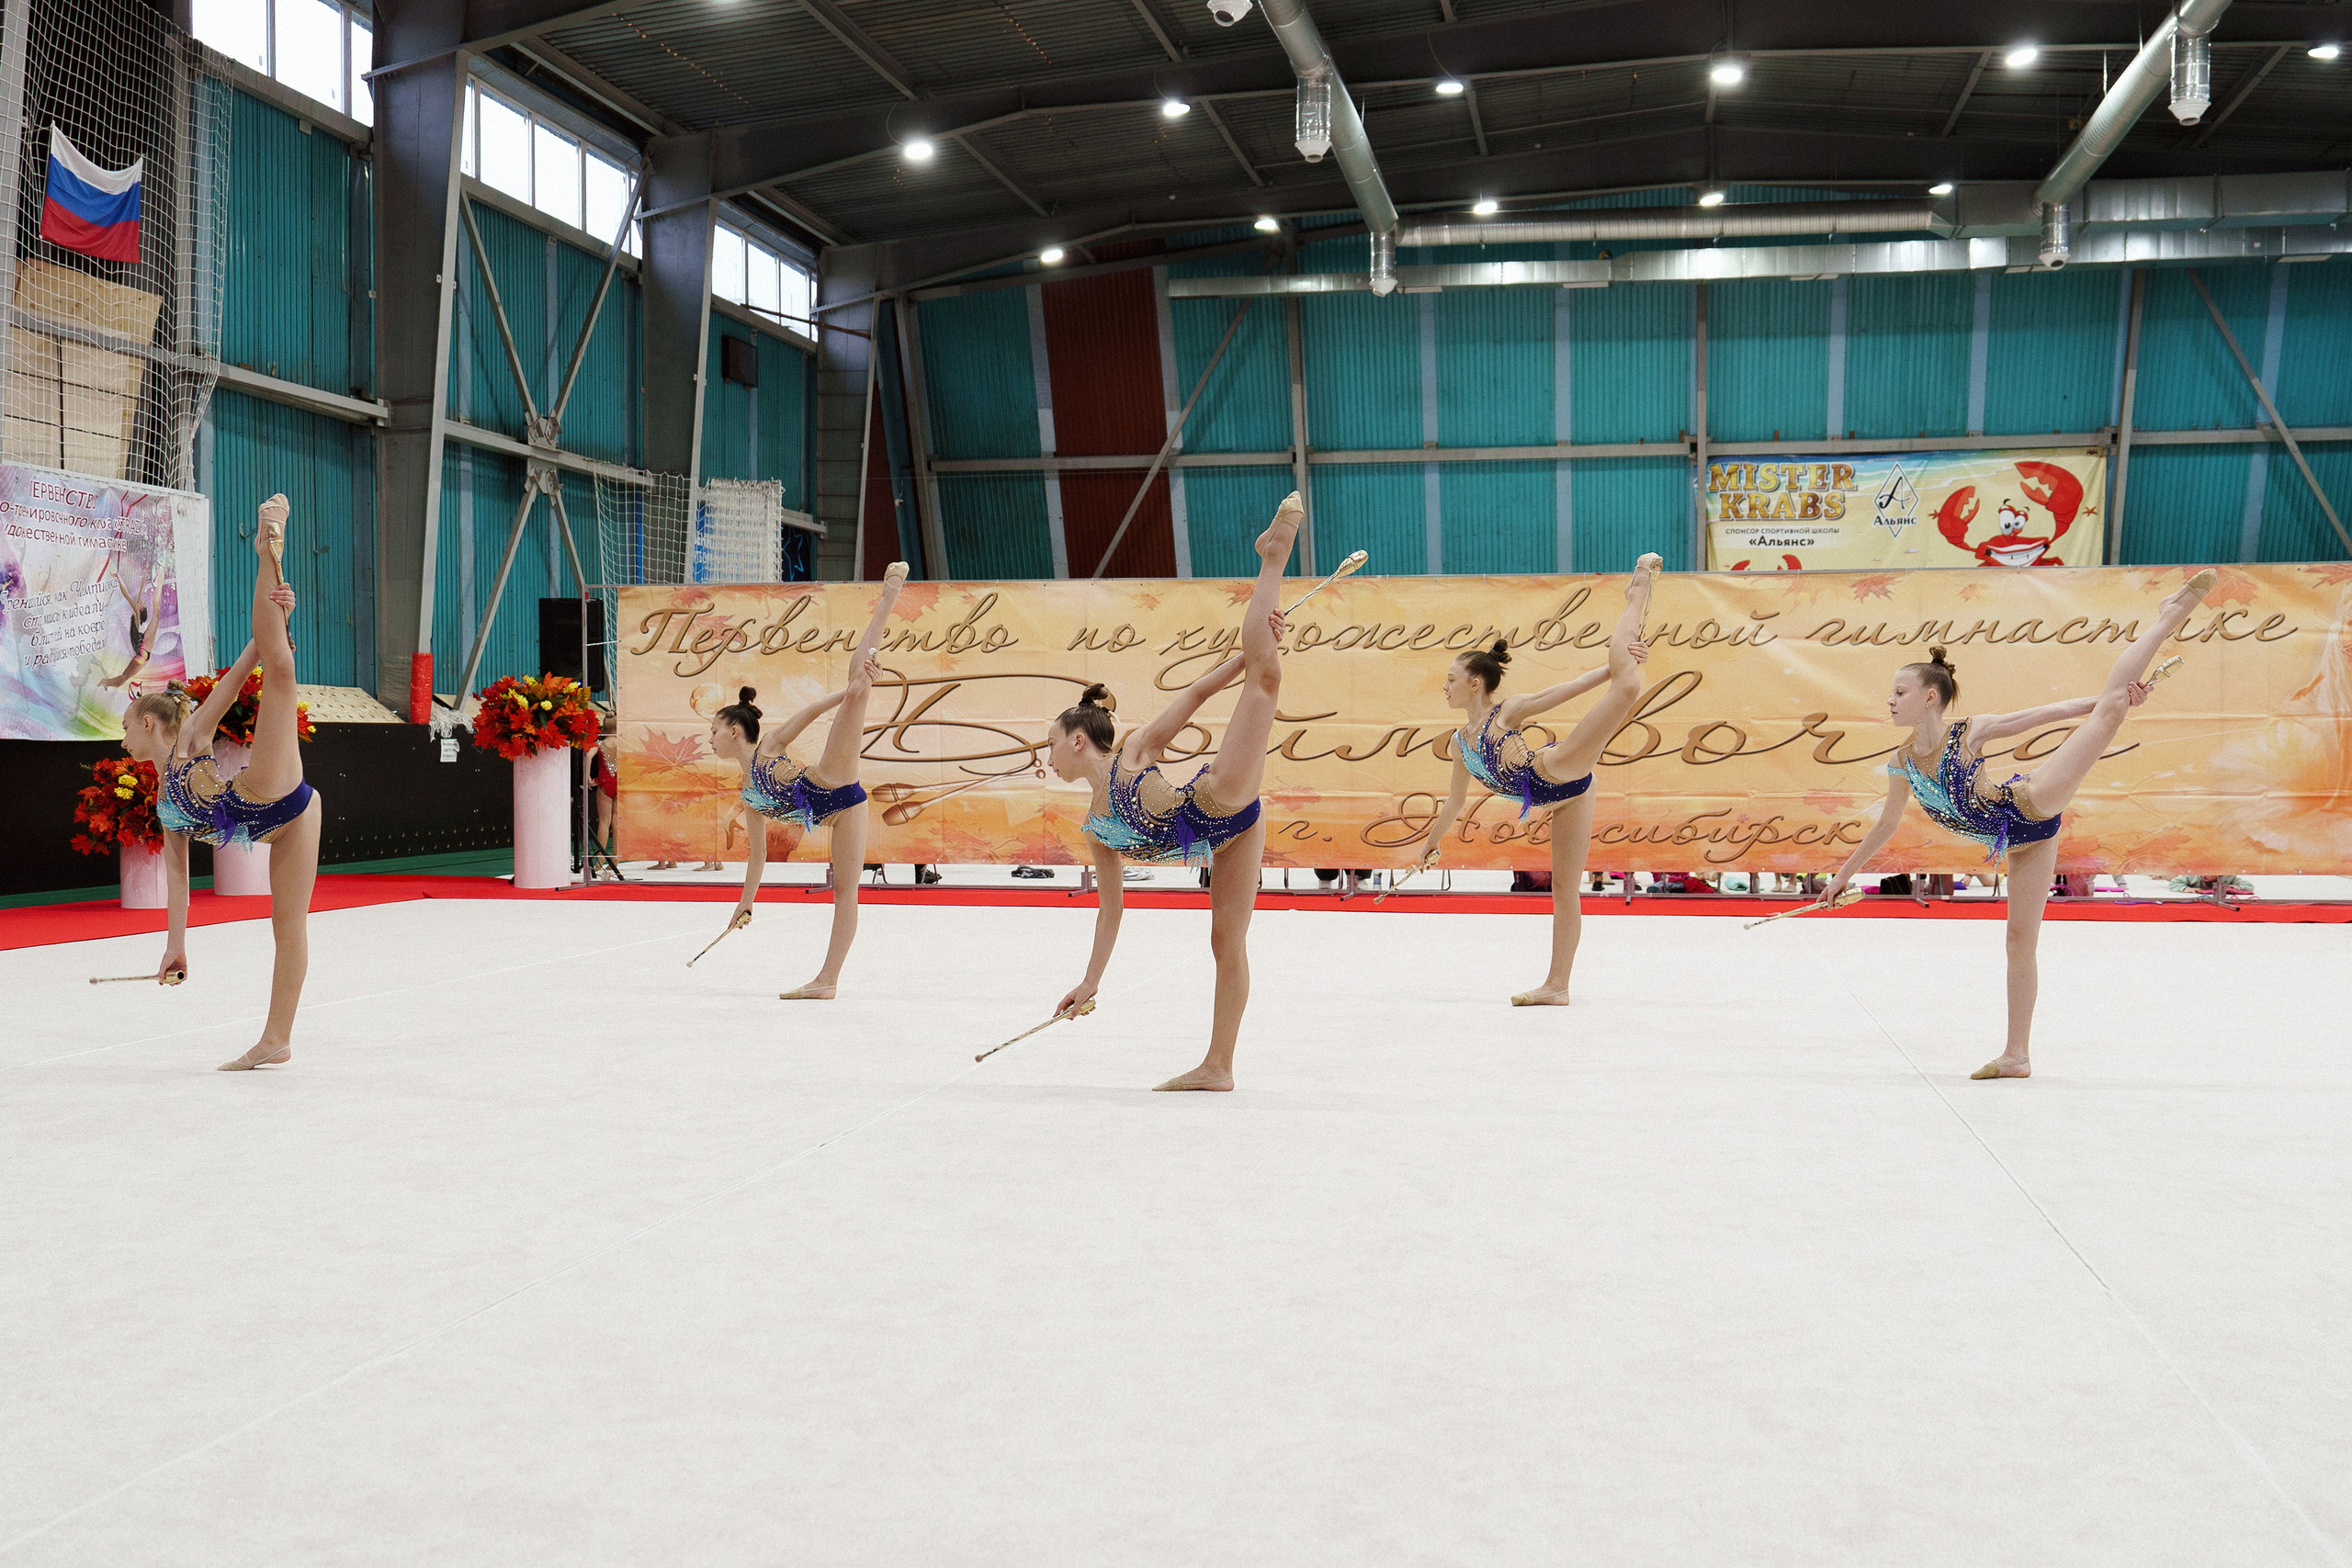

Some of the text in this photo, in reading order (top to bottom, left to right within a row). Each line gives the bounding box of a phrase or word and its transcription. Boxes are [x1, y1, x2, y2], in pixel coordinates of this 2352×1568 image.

[1708, 462, 1858, 491] MISTER
[30, 480, 98, 509] ЕРВЕНСТВ
[1719, 491, 1846, 520] KRABS
[1873, 514, 1917, 526] Альянс
[1749, 536, 1815, 547] «Альянс»
[1067, 623, 1147, 652] по
[1154, 585, 1781, 691] хуожественой
[1278, 792, 1865, 863] г. Новсибирск
